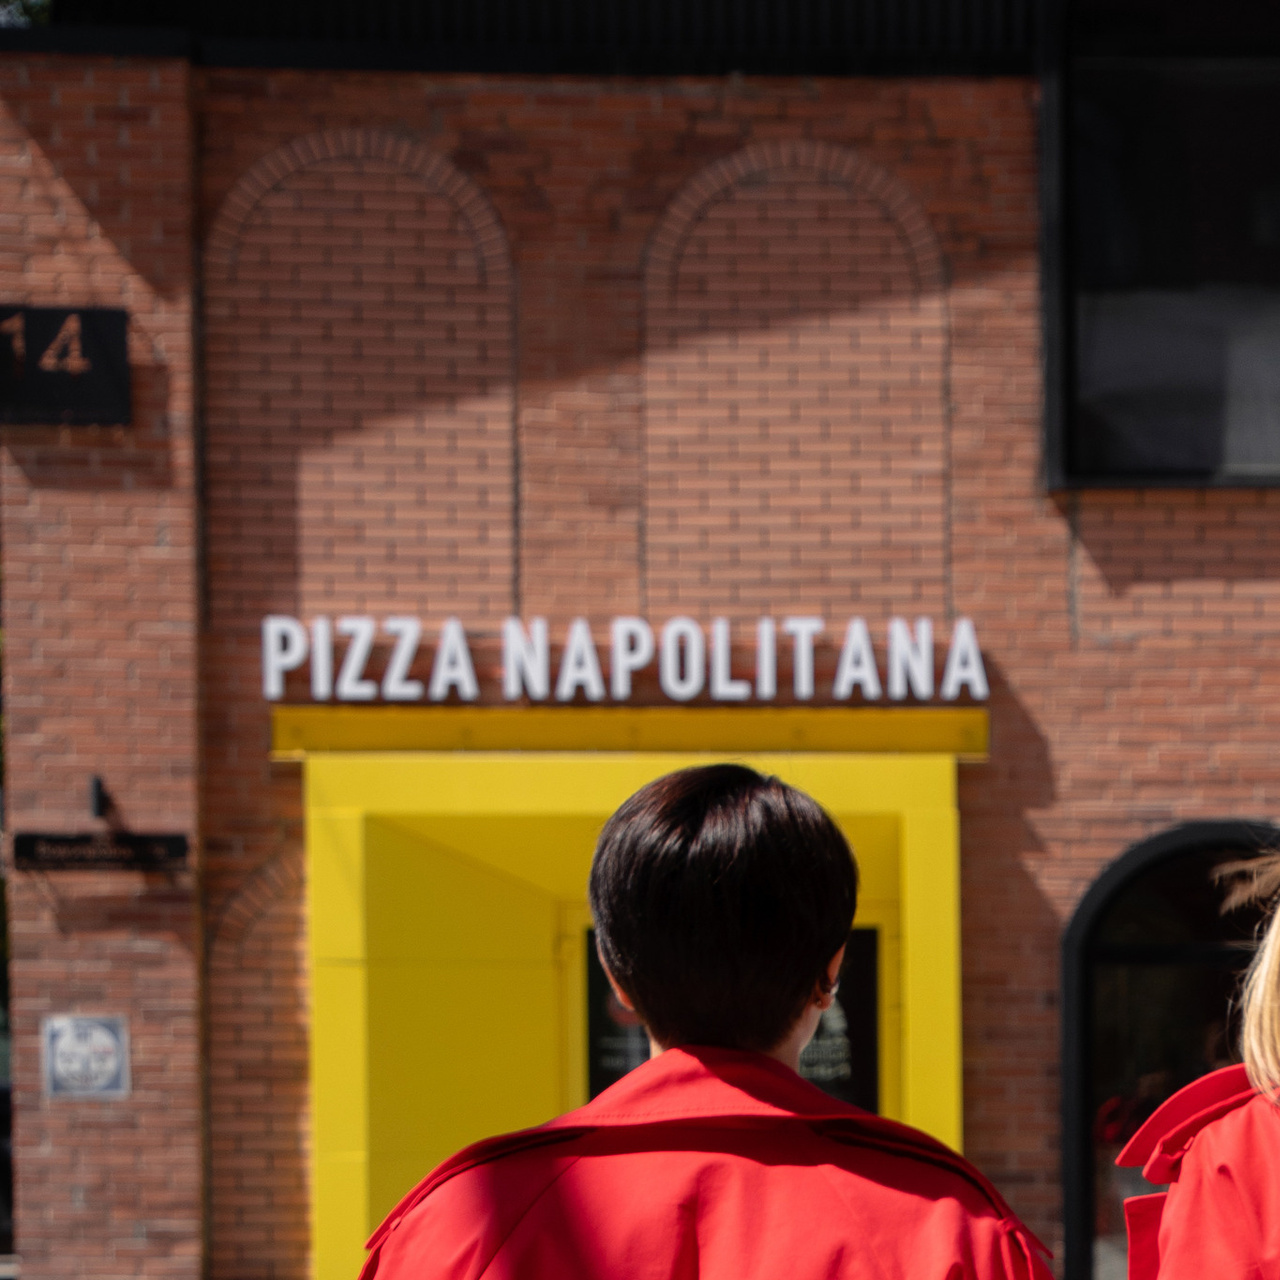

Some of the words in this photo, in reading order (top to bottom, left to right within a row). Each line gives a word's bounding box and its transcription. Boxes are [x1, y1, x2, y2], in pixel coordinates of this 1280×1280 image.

[0, 311, 92, 378] 14
[261, 614, 480, 701] PIZZA
[502, 614, 990, 701] NAPOLITANA
